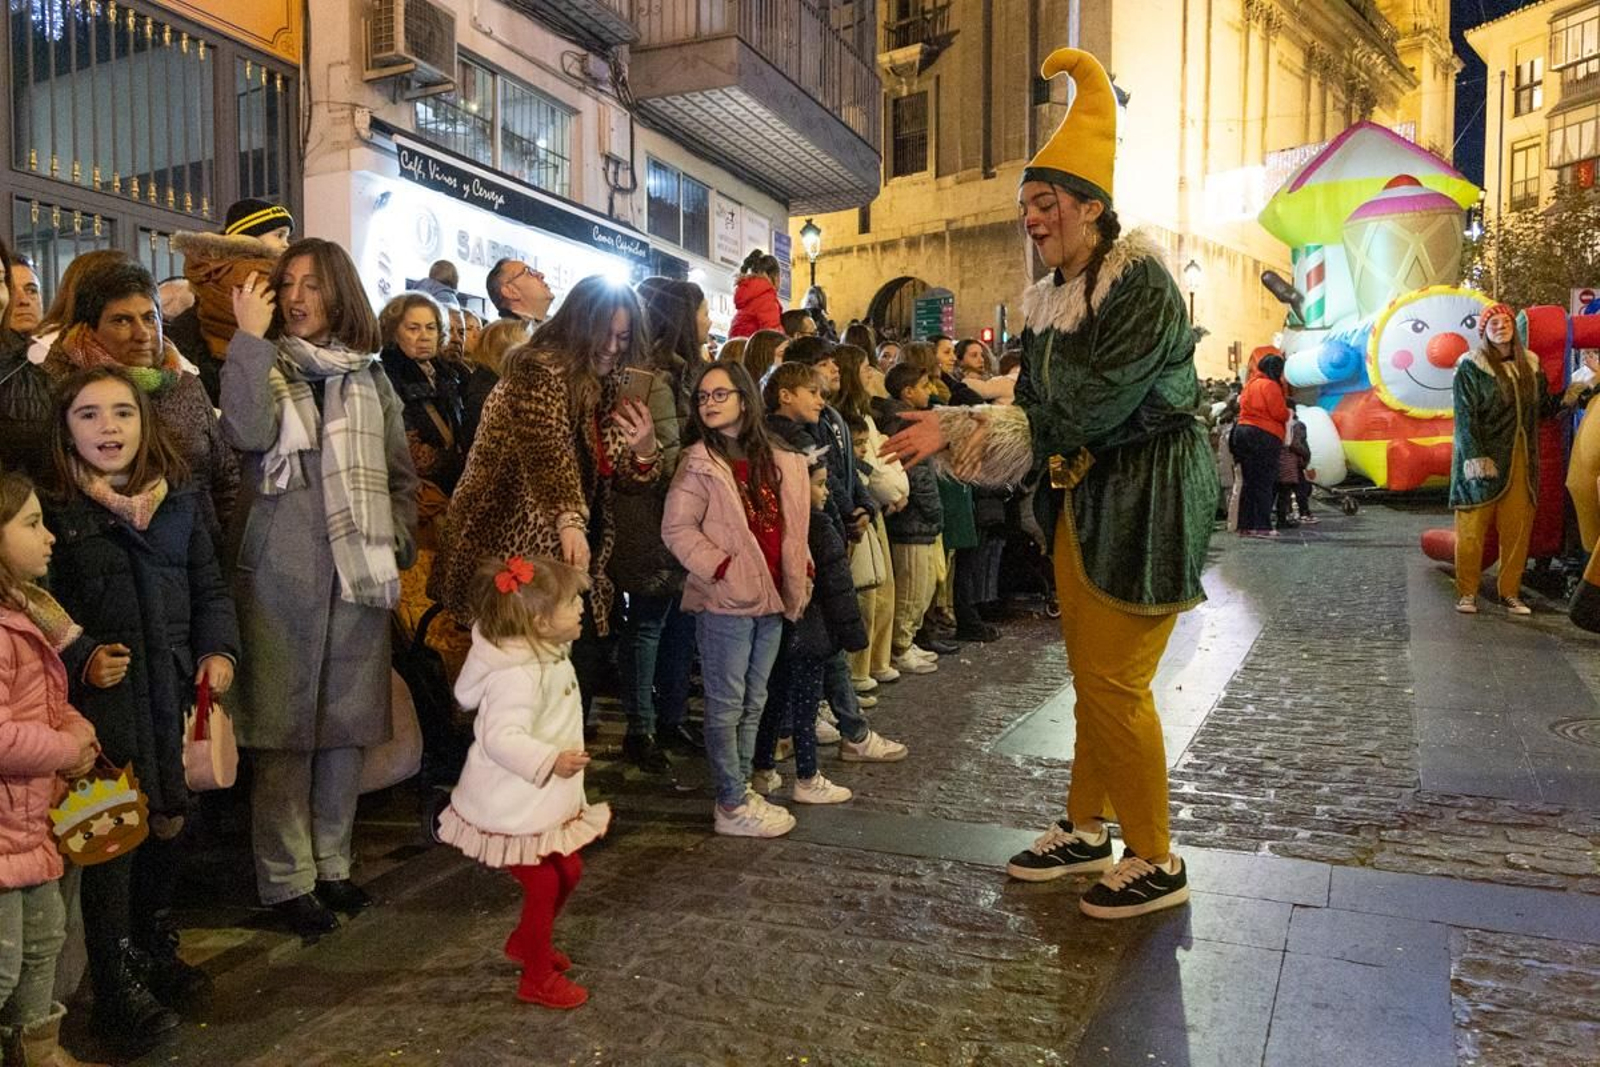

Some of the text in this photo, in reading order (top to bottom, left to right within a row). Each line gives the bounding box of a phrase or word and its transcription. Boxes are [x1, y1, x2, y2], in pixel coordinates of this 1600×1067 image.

[429, 159, 457, 188] Vinos
[463, 184, 470, 199] y
[472, 178, 505, 210] Cerveza
